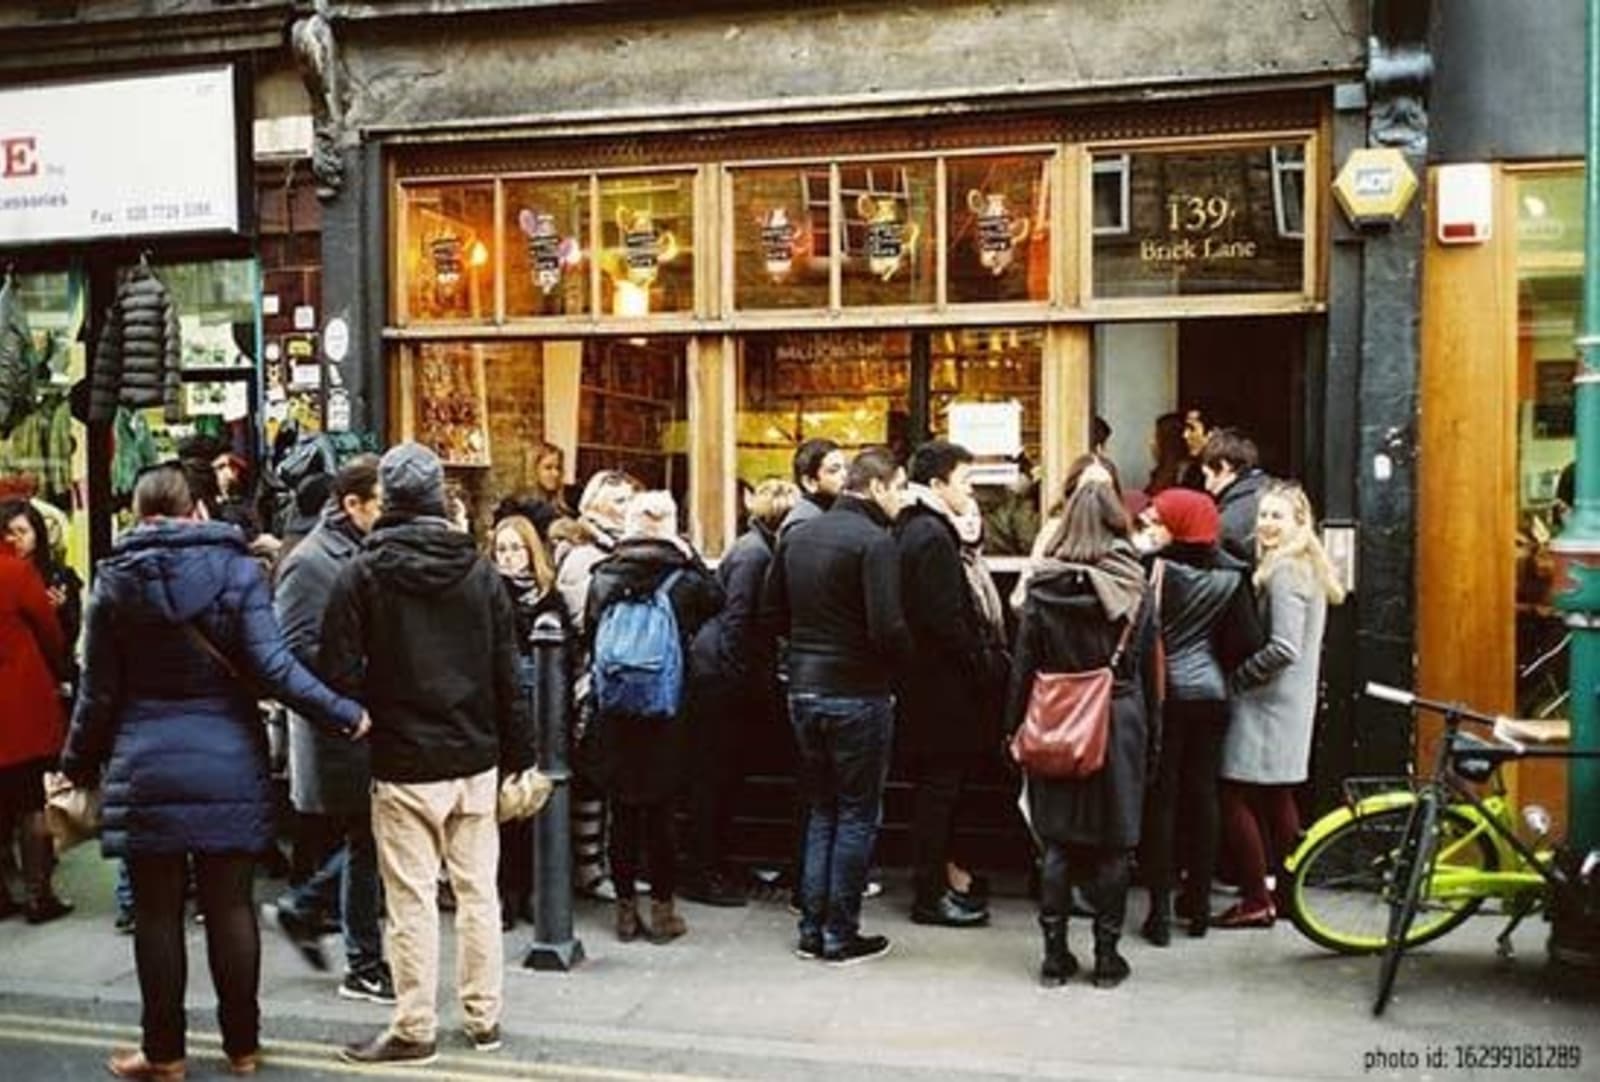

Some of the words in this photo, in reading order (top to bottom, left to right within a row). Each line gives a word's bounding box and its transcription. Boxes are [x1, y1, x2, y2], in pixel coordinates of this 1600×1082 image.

[1165, 195, 1229, 231] 139
[1140, 238, 1197, 261] Brick
[1203, 238, 1258, 260] Lane
